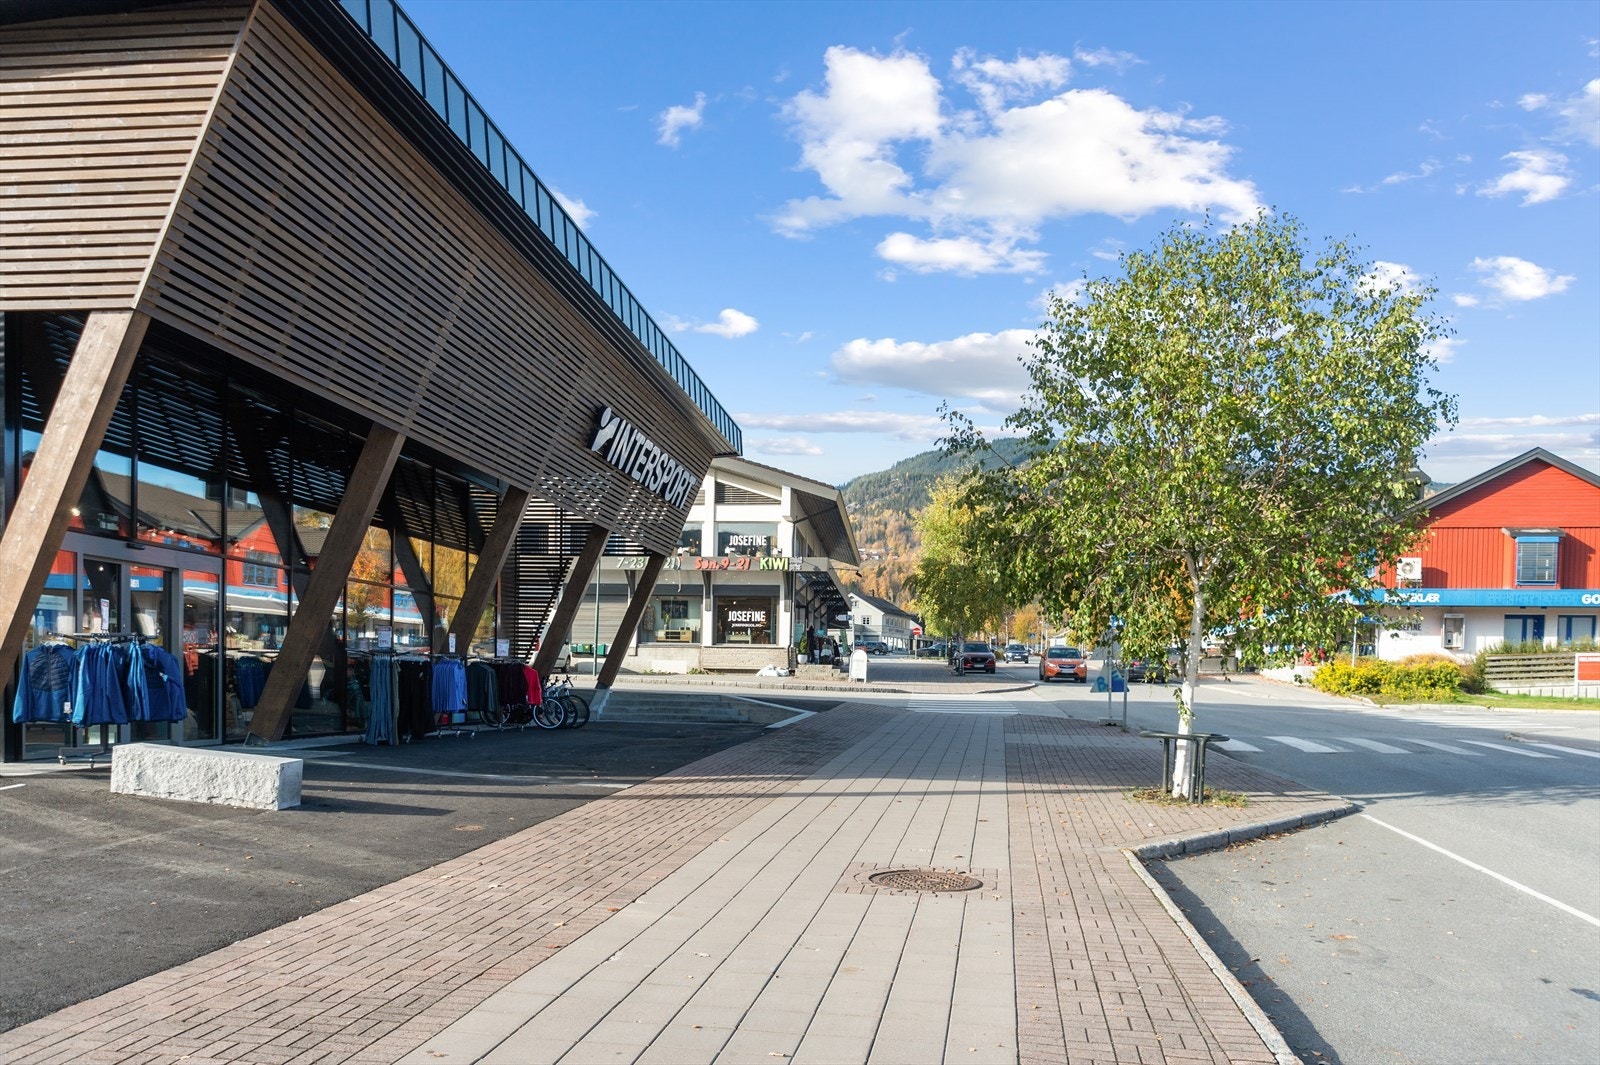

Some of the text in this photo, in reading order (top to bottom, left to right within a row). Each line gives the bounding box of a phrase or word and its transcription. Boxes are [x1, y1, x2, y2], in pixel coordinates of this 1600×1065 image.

[606, 419, 697, 509] INTERSPORT
[729, 535, 767, 546] JOSEFINE
[759, 557, 788, 570] KIWI
[728, 610, 766, 622] JOSEFINE
